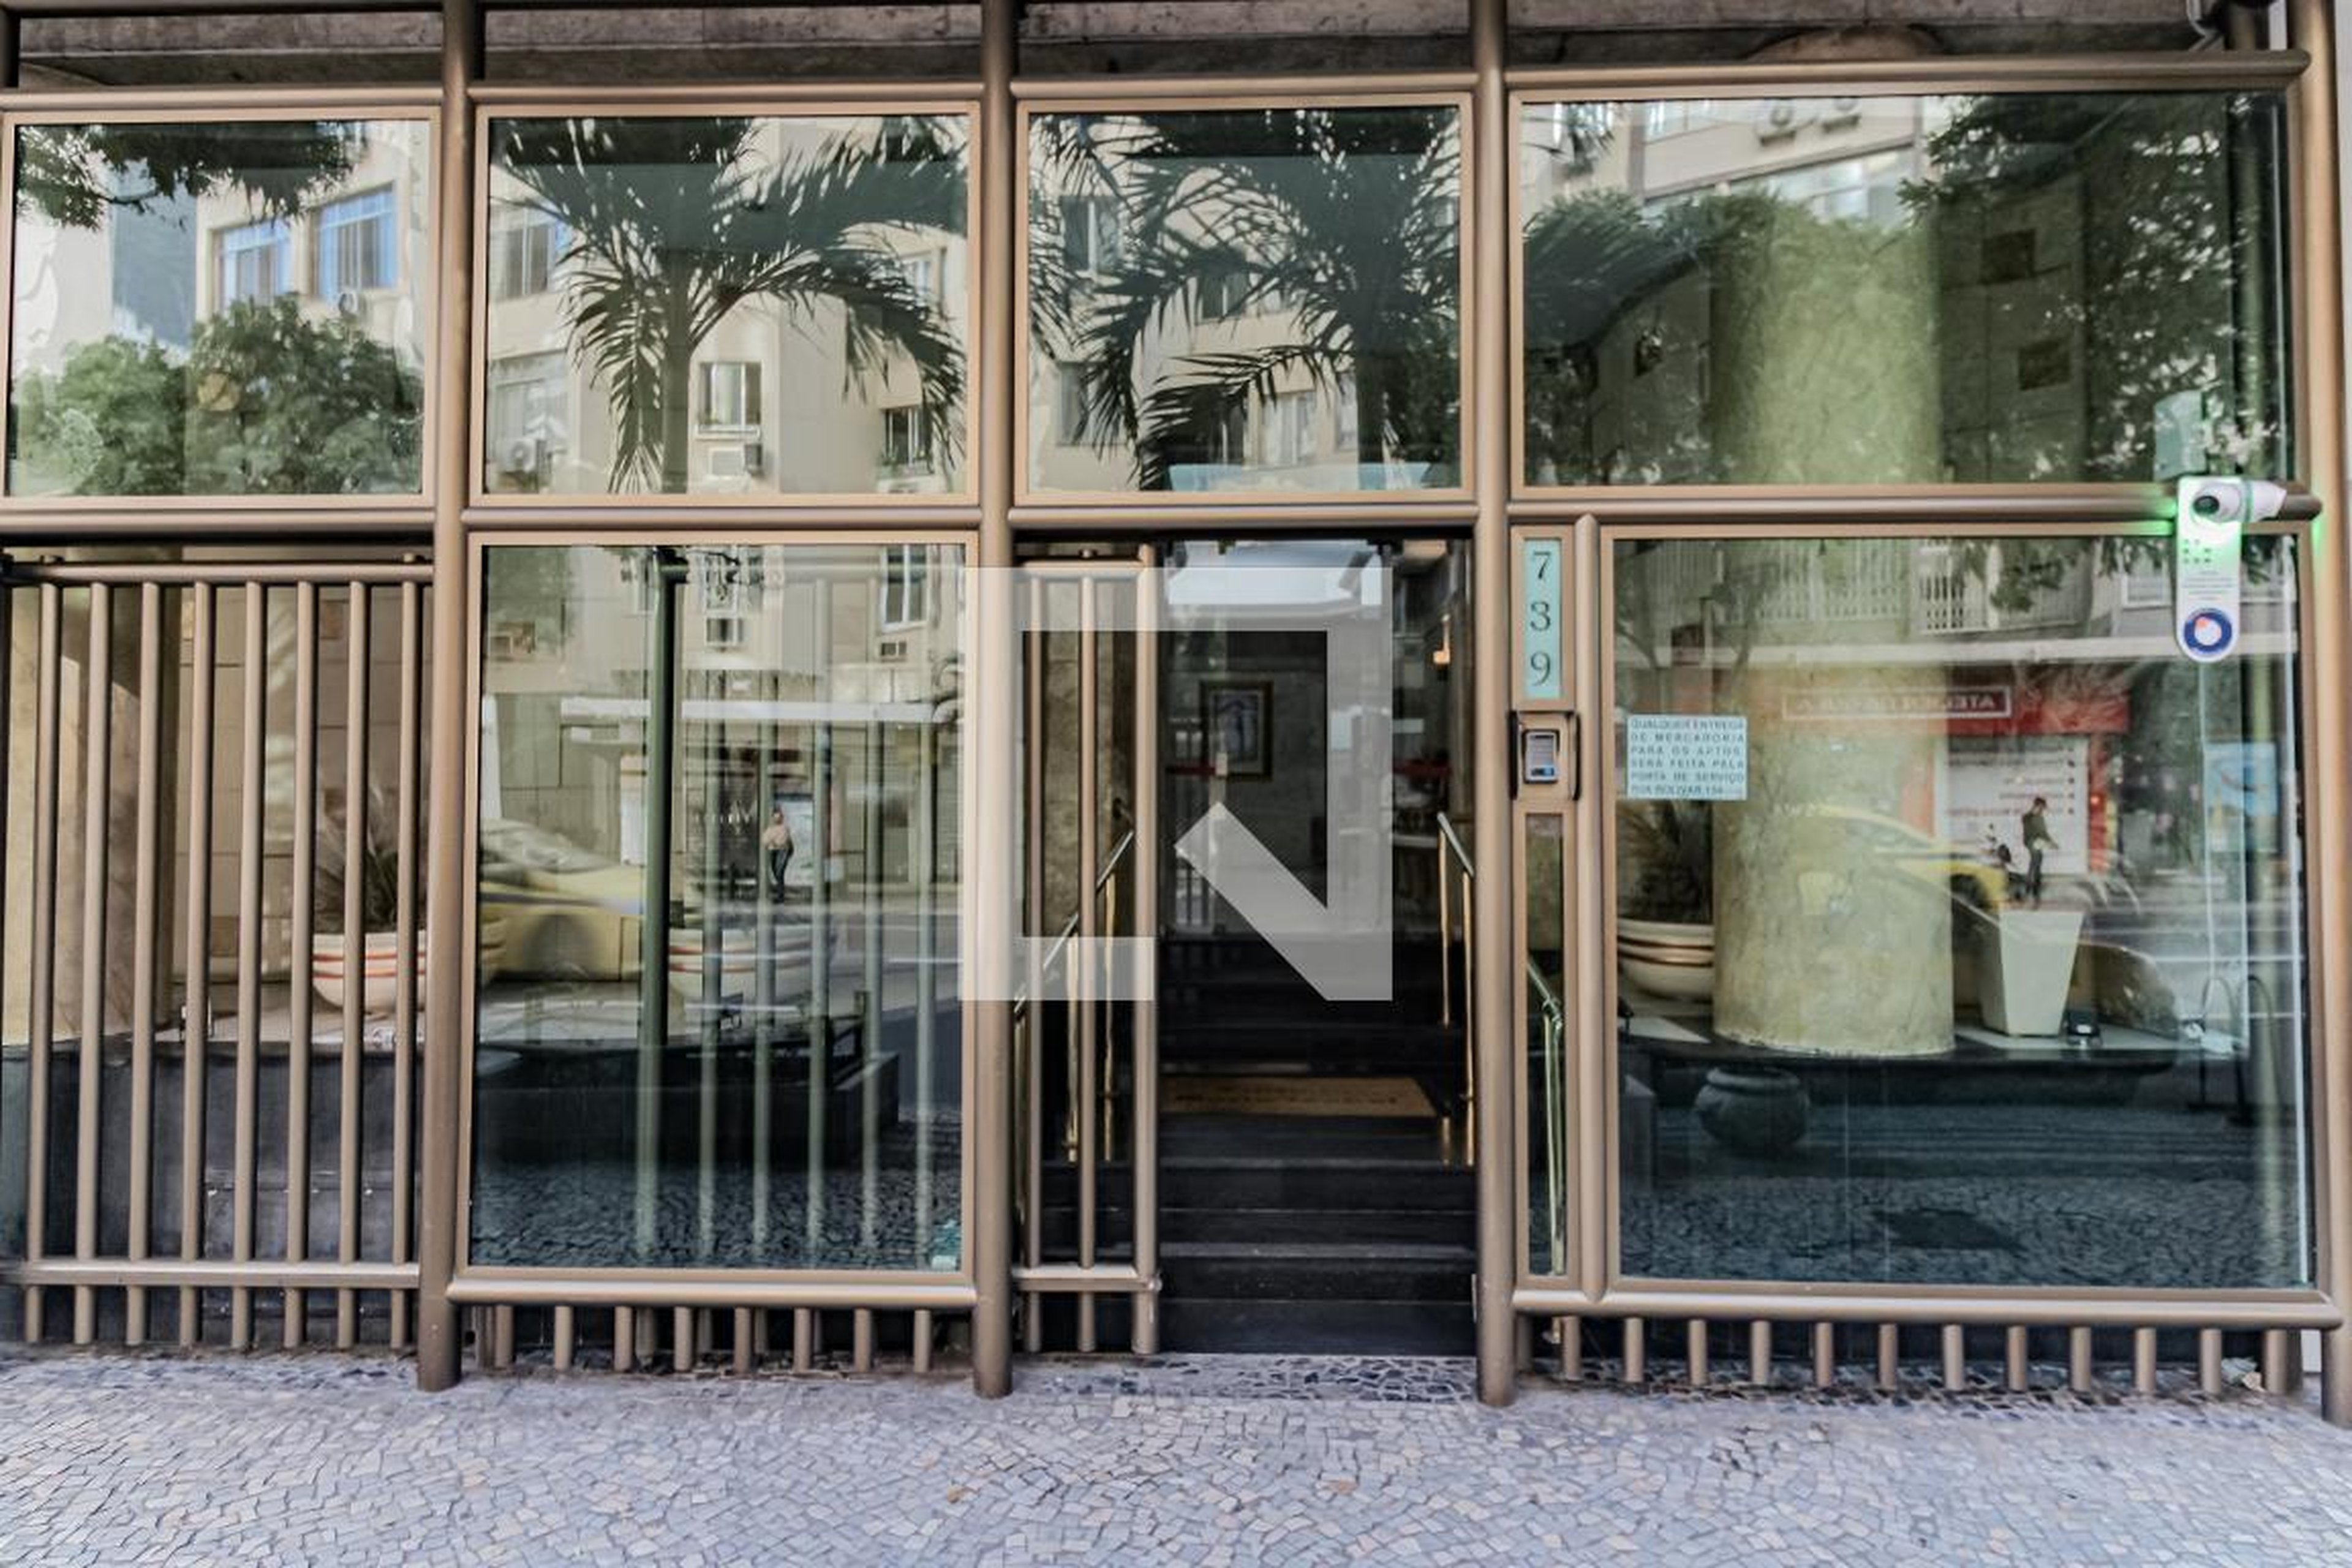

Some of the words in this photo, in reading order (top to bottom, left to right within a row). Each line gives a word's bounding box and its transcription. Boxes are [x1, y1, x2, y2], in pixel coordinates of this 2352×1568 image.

[1530, 551, 1551, 686] 739
[1631, 733, 1646, 742] DE
[1655, 733, 1744, 742] MERCADORIA
[1631, 745, 1664, 755] PARA
[1672, 745, 1689, 755] OS
[1670, 759, 1705, 767] FEITA
[1673, 772, 1687, 781] DE
